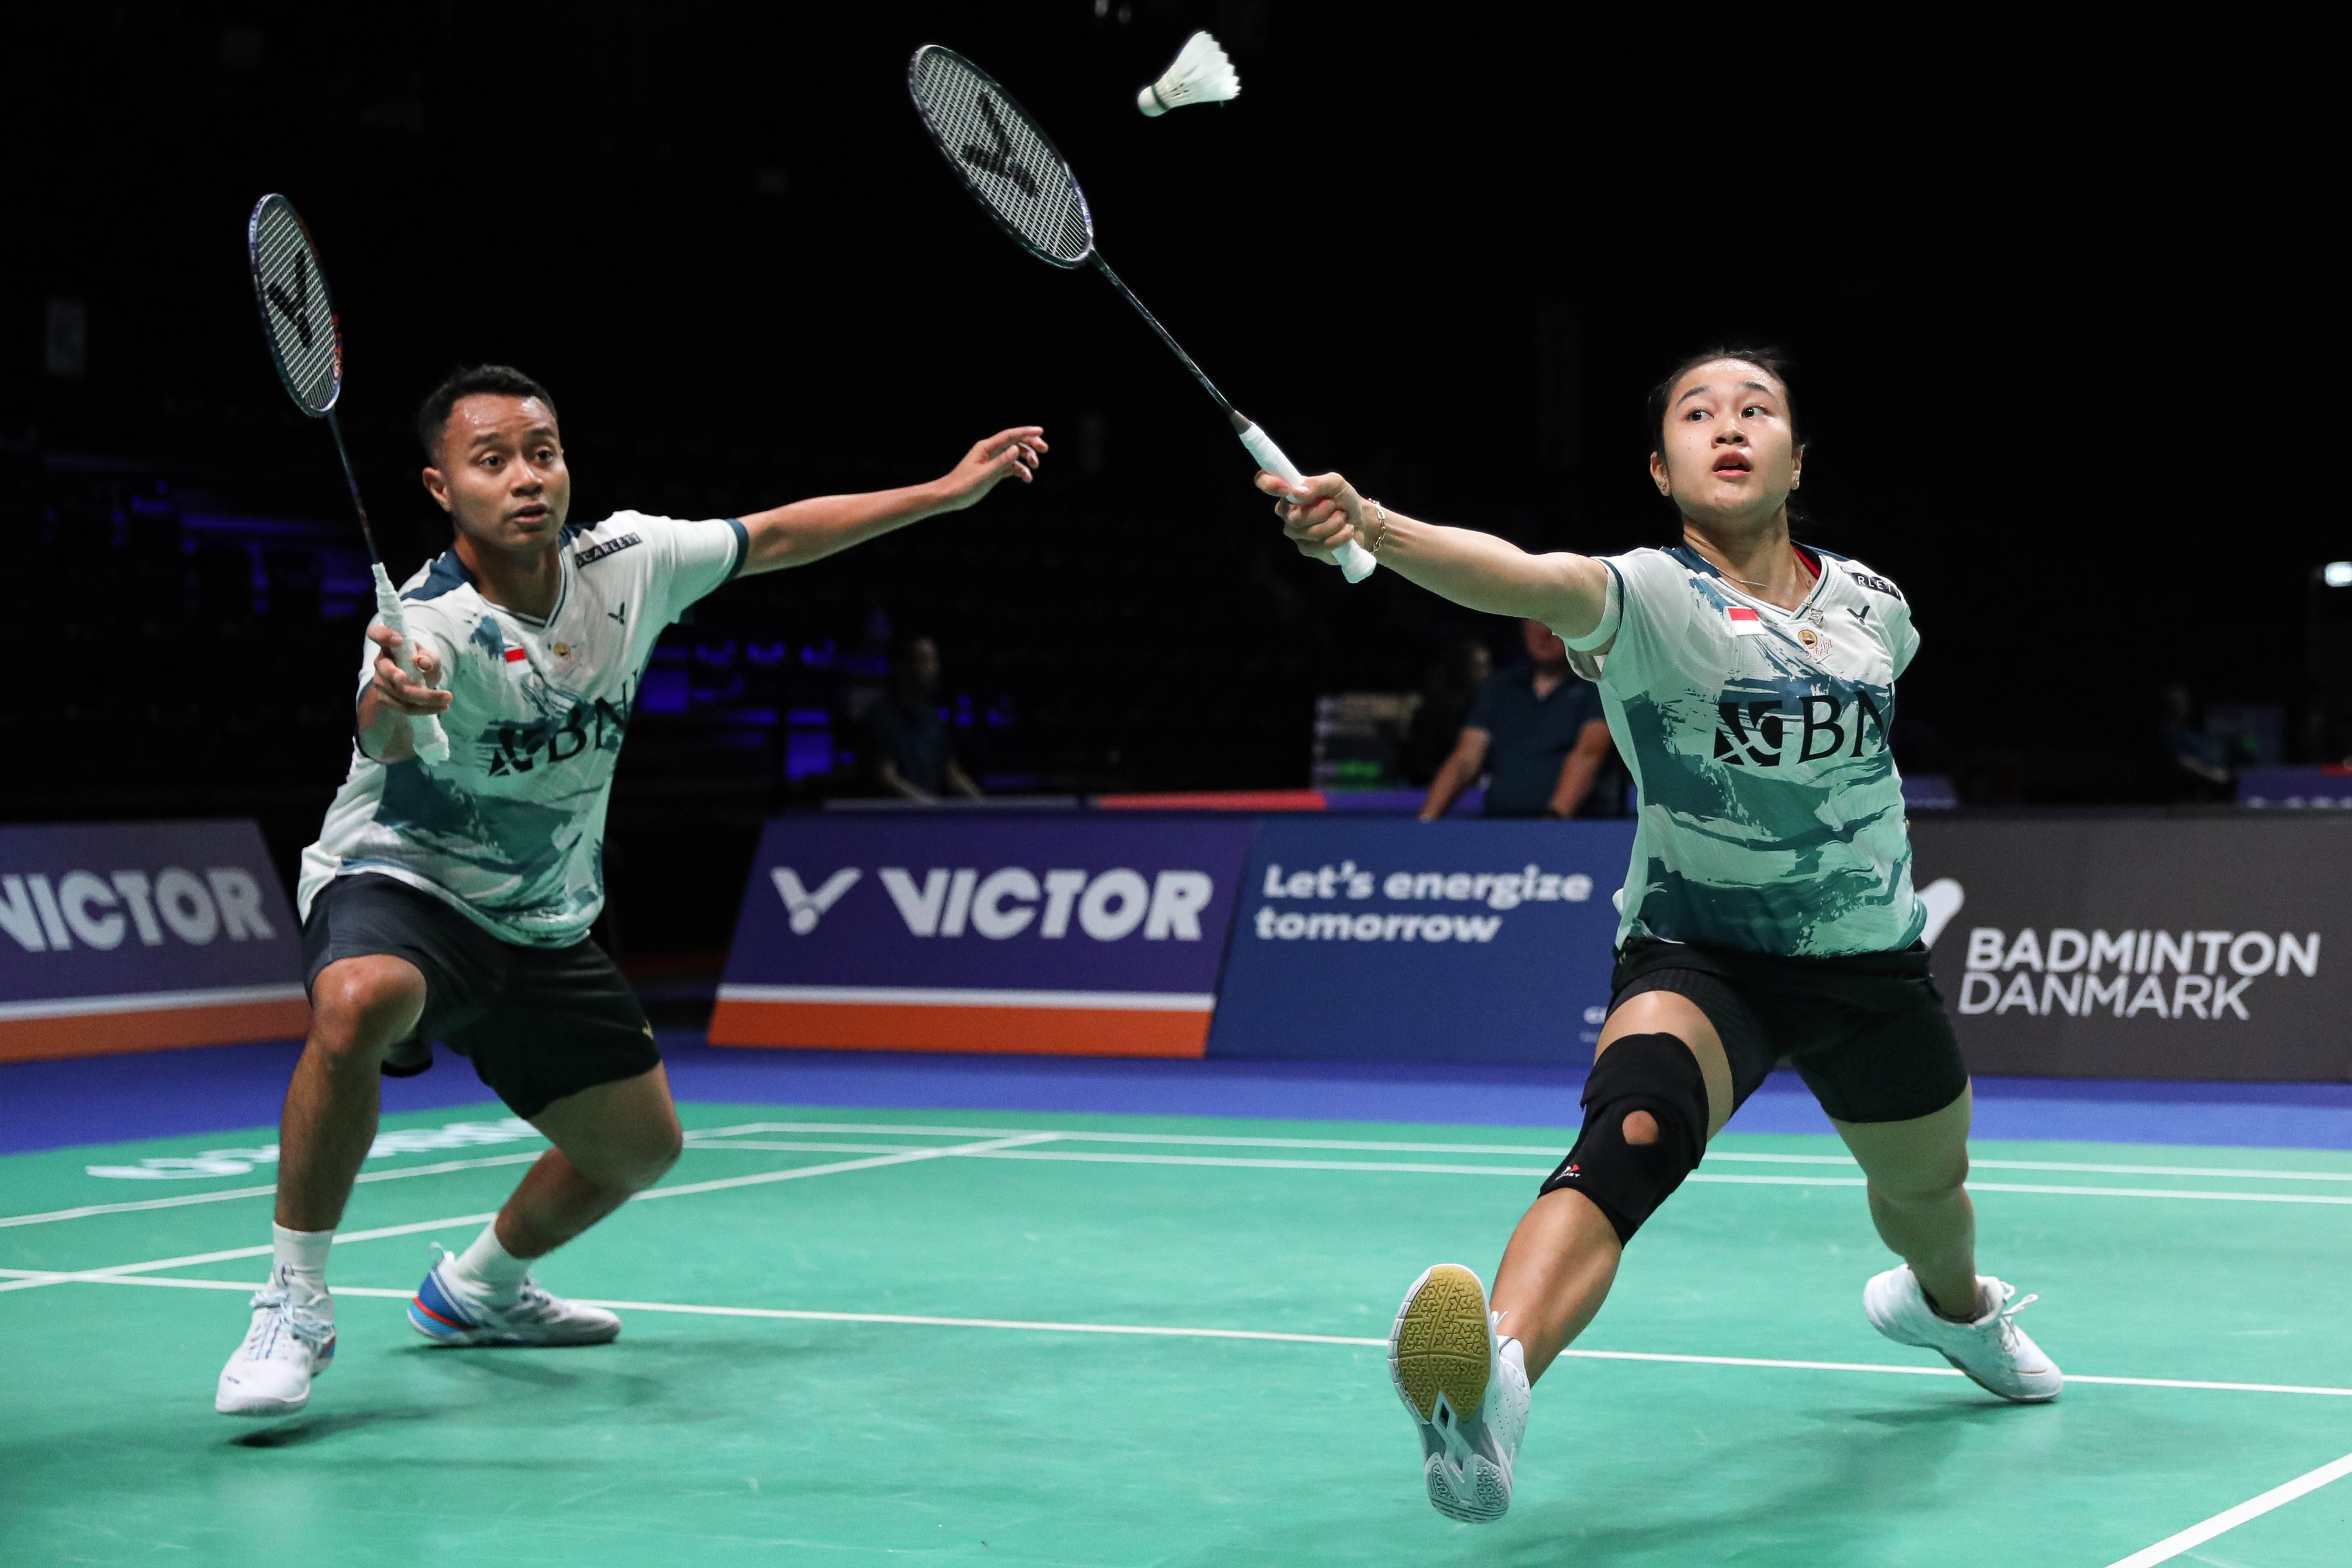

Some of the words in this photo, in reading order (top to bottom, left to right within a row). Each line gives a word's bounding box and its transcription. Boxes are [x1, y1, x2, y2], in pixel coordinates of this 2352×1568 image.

[0, 867, 277, 952] VICTOR
[877, 865, 1214, 941] VICTOR
[1262, 860, 1375, 899] Let's
[1382, 864, 1593, 910] energize
[1255, 905, 1502, 942] tomorrow
[1965, 927, 2321, 978] BADMINTON
[1958, 970, 2255, 1020] DANMARK
